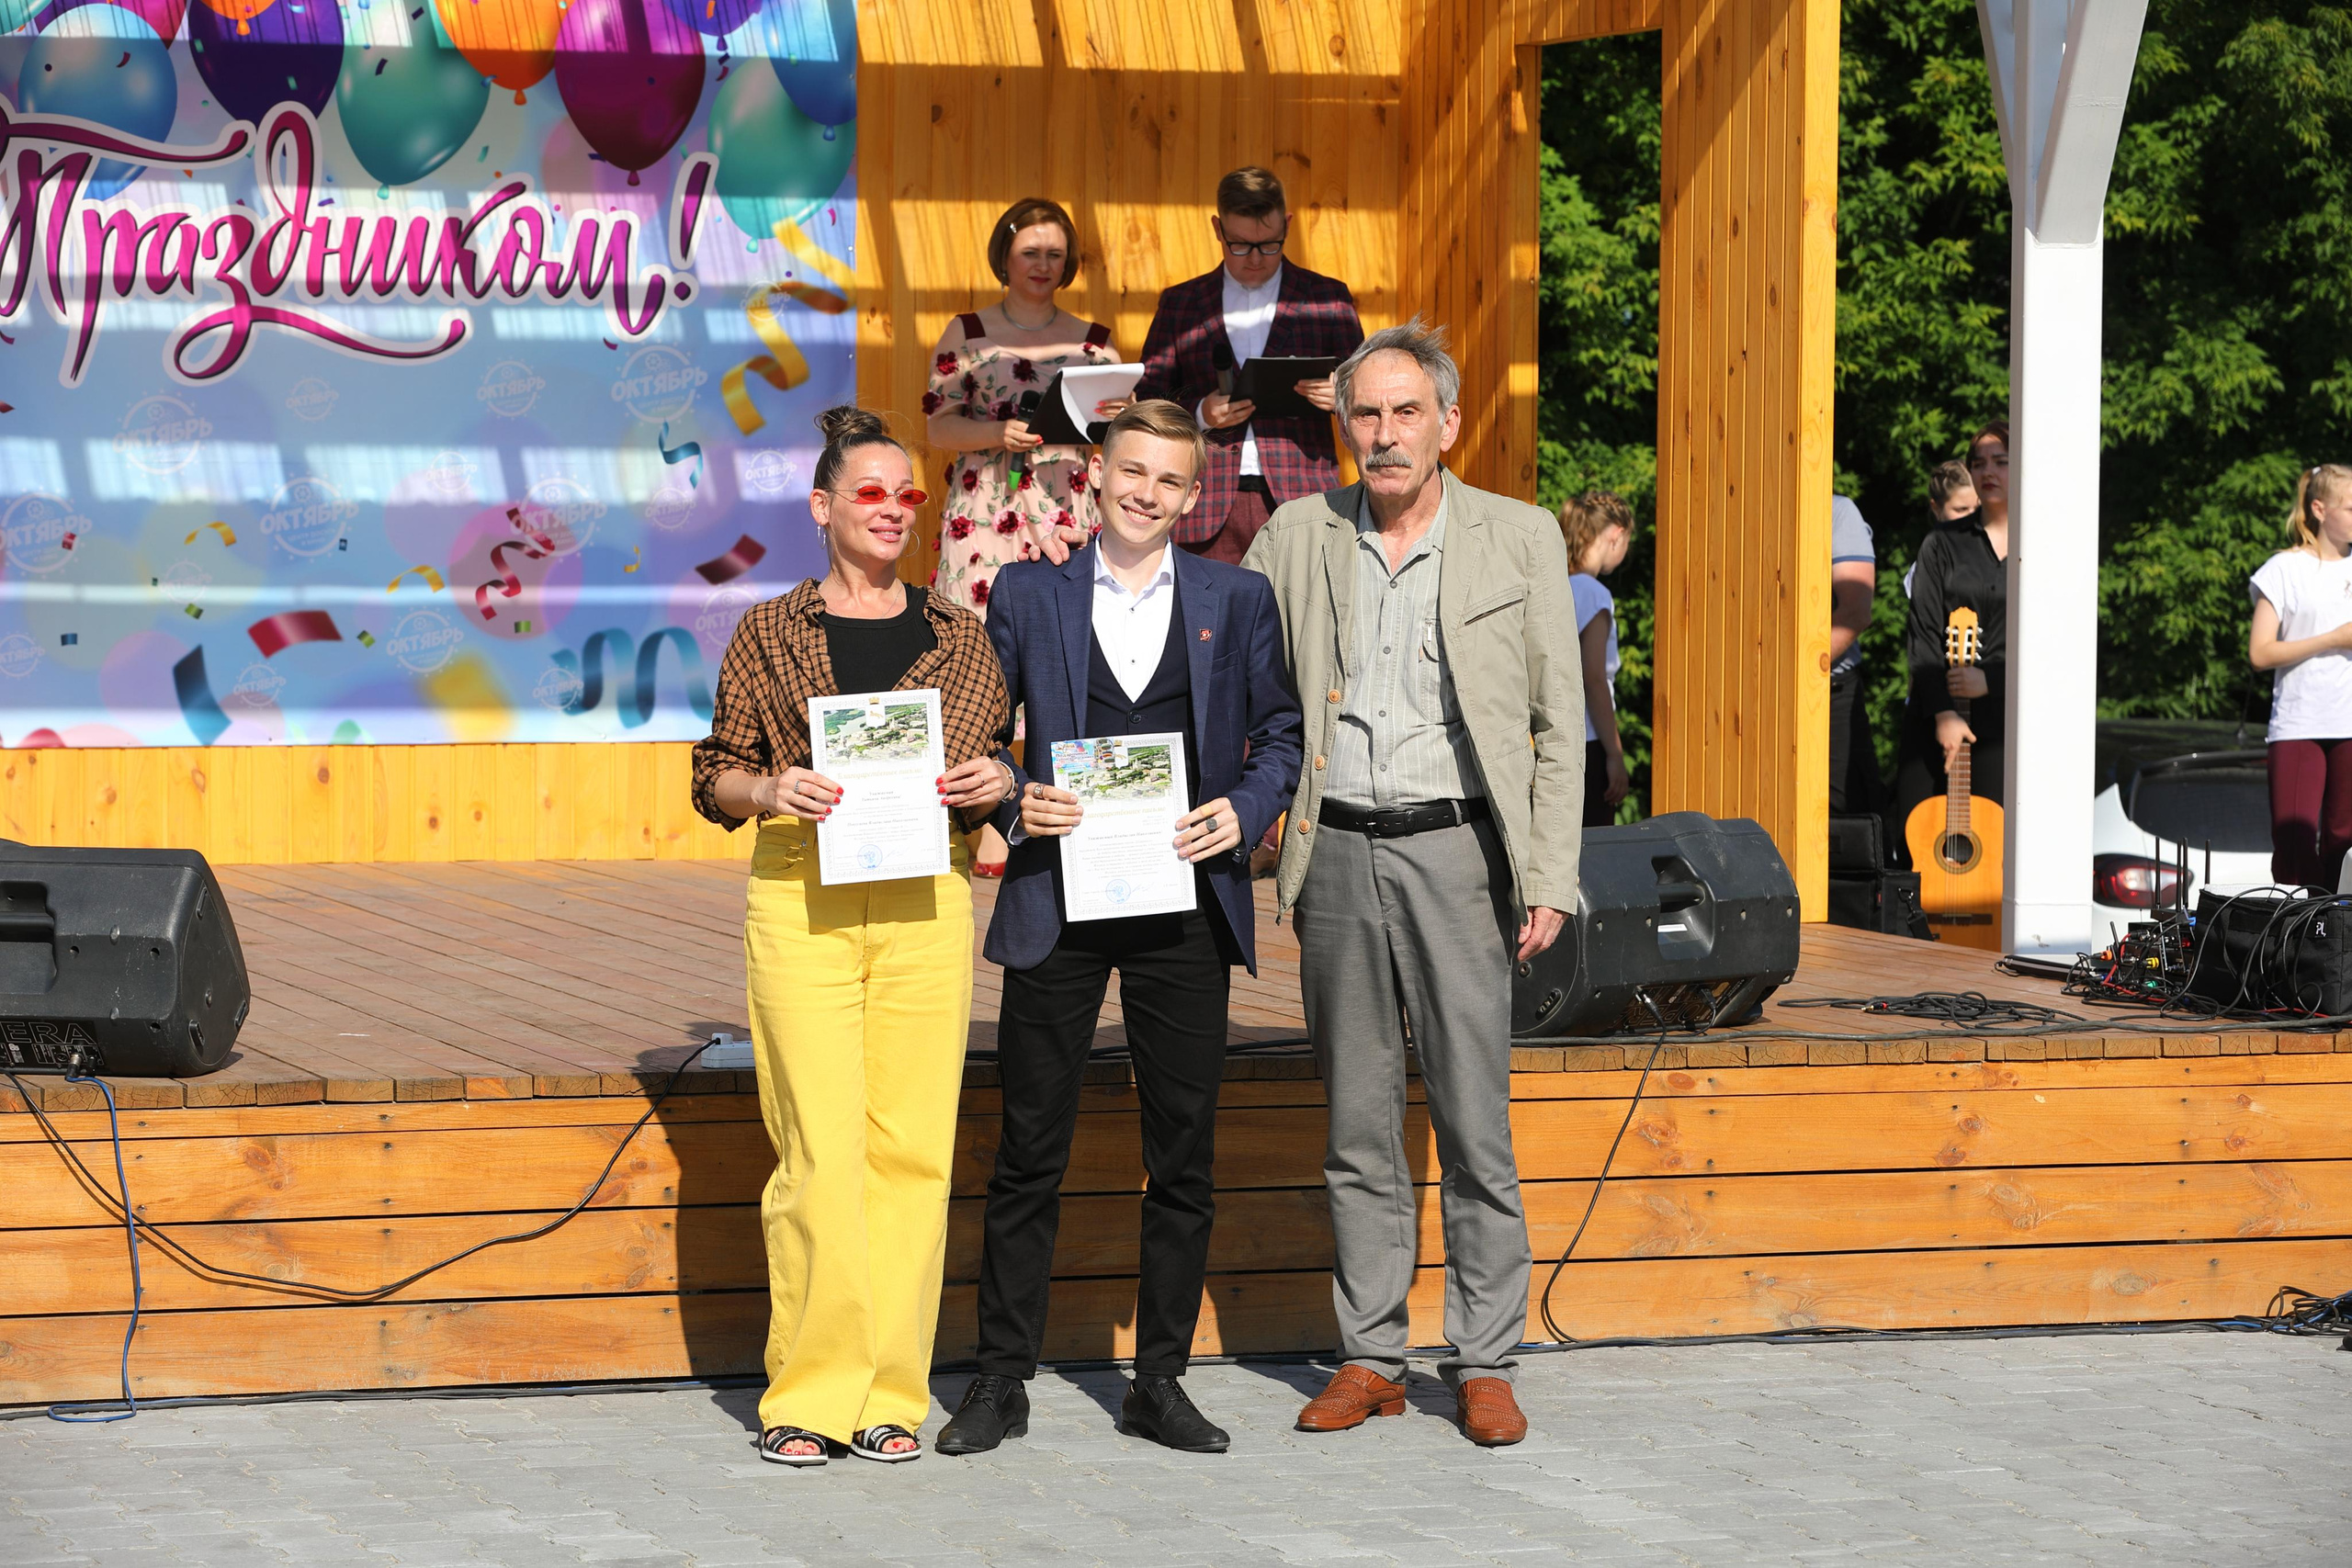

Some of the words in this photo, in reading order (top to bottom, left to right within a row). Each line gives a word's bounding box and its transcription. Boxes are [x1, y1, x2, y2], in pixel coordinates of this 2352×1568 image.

[0, 110, 711, 381] Праздником!
[477, 376, 546, 401] ОКТЯБРЬ
[611, 366, 708, 401] ОКТЯБРЬ
[112, 416, 213, 453] ОКТЯБРЬ
[745, 460, 797, 480] ОКТЯБРЬ
[260, 499, 359, 535] ОКТЯБРЬ
[510, 500, 607, 535] ОКТЯБРЬ
[386, 627, 464, 656] ОКТЯБРЬ
[233, 676, 287, 696] ОКТЯБРЬ
[533, 679, 583, 698] ОКТЯБРЬ
